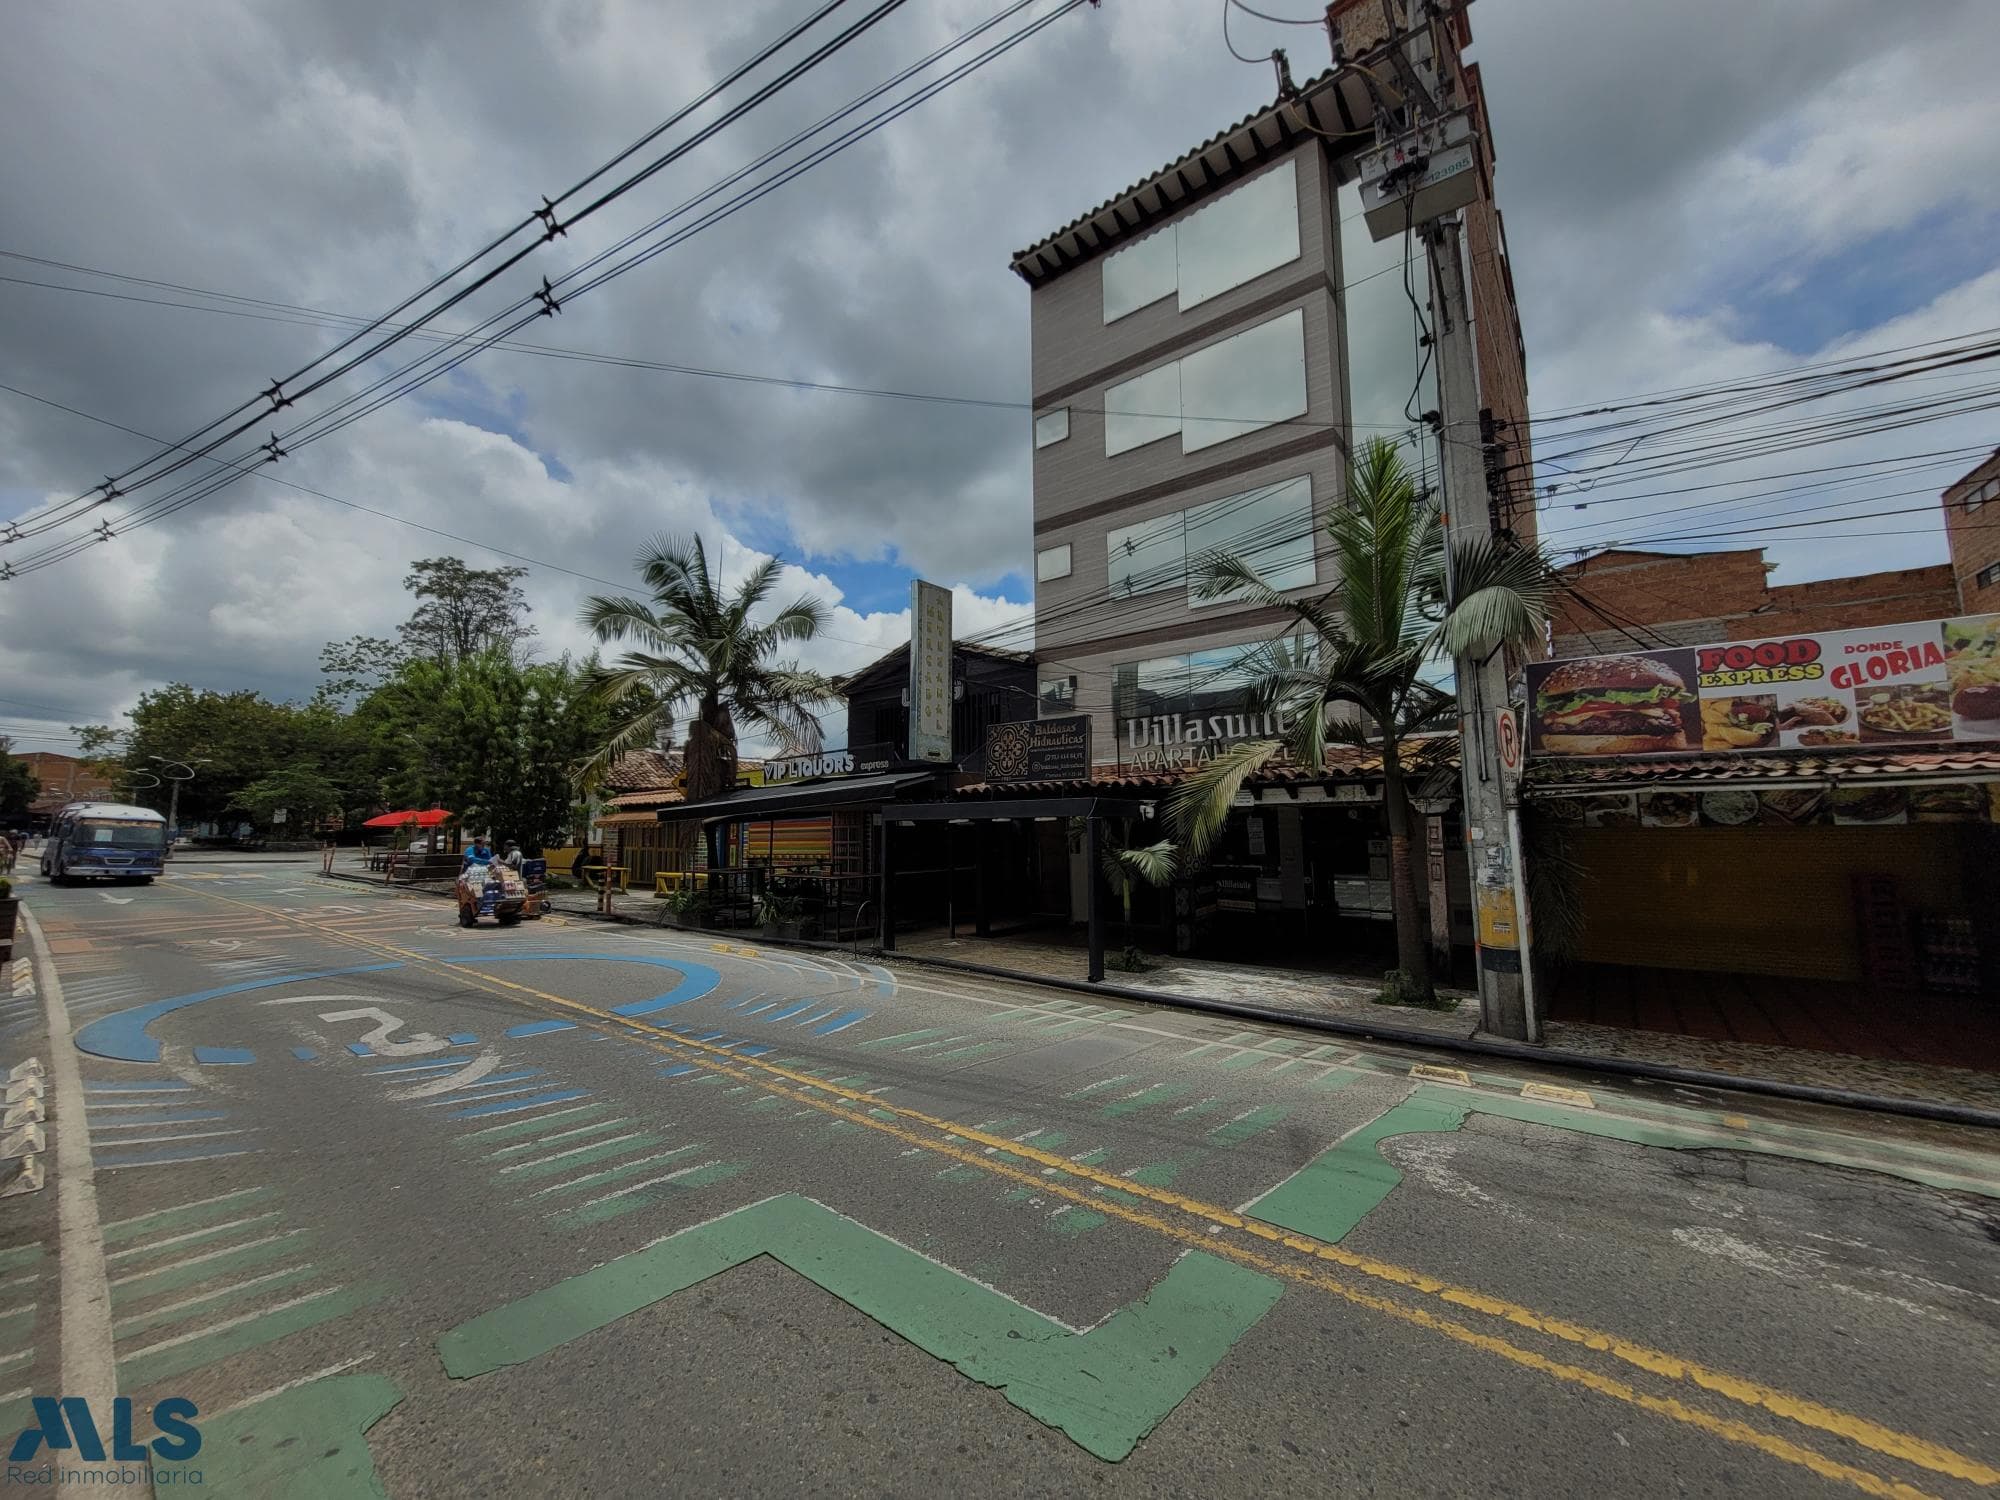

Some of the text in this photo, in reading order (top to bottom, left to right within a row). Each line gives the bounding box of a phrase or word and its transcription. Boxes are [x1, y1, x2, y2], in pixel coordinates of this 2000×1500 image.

[1698, 638, 1821, 674] FOOD
[1844, 640, 1903, 654] DONDE
[1699, 663, 1824, 688] EXPRESS
[1830, 641, 1946, 690] GLORIA
[764, 754, 889, 781] VIP LIQUORS express
[1130, 742, 1295, 772] APARTAHL
